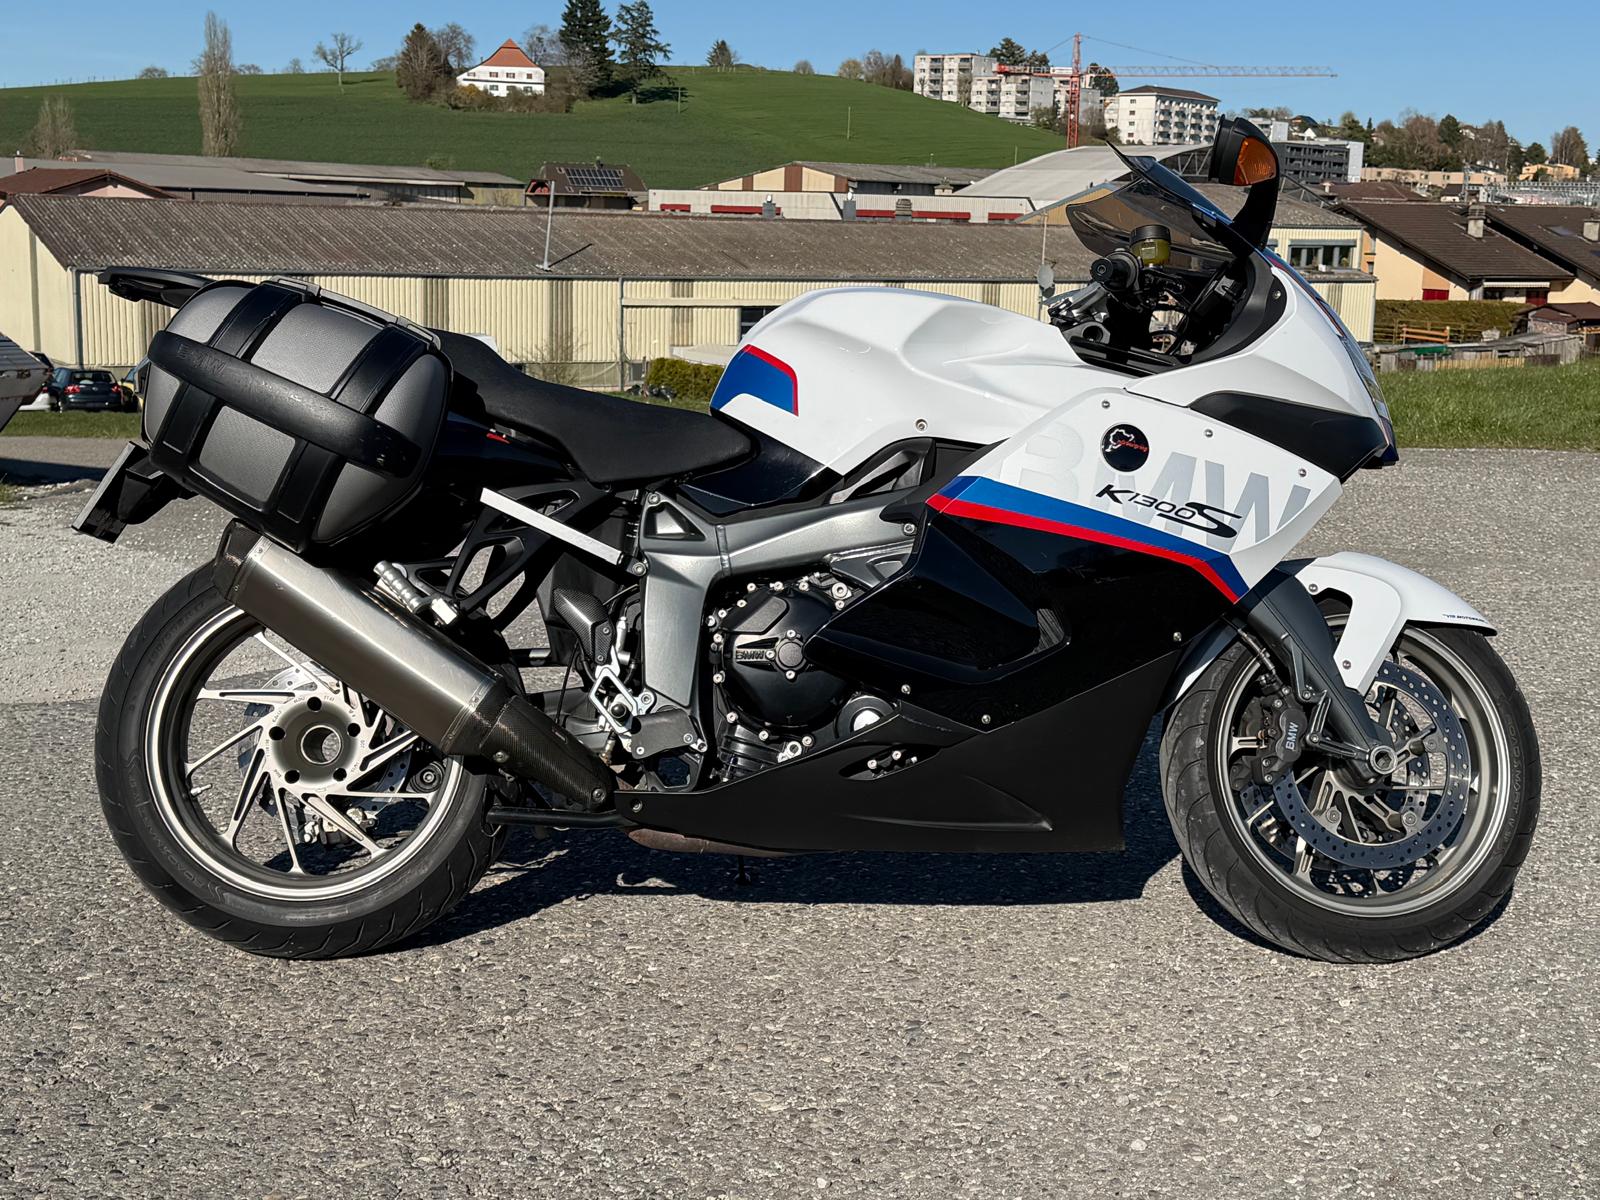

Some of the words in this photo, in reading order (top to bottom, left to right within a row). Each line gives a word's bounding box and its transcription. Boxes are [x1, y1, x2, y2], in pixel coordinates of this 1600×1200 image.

[1000, 420, 1311, 553] BMW
[1096, 484, 1242, 538] K1300S
[735, 650, 764, 660] BMW
[1285, 721, 1299, 751] BMW
